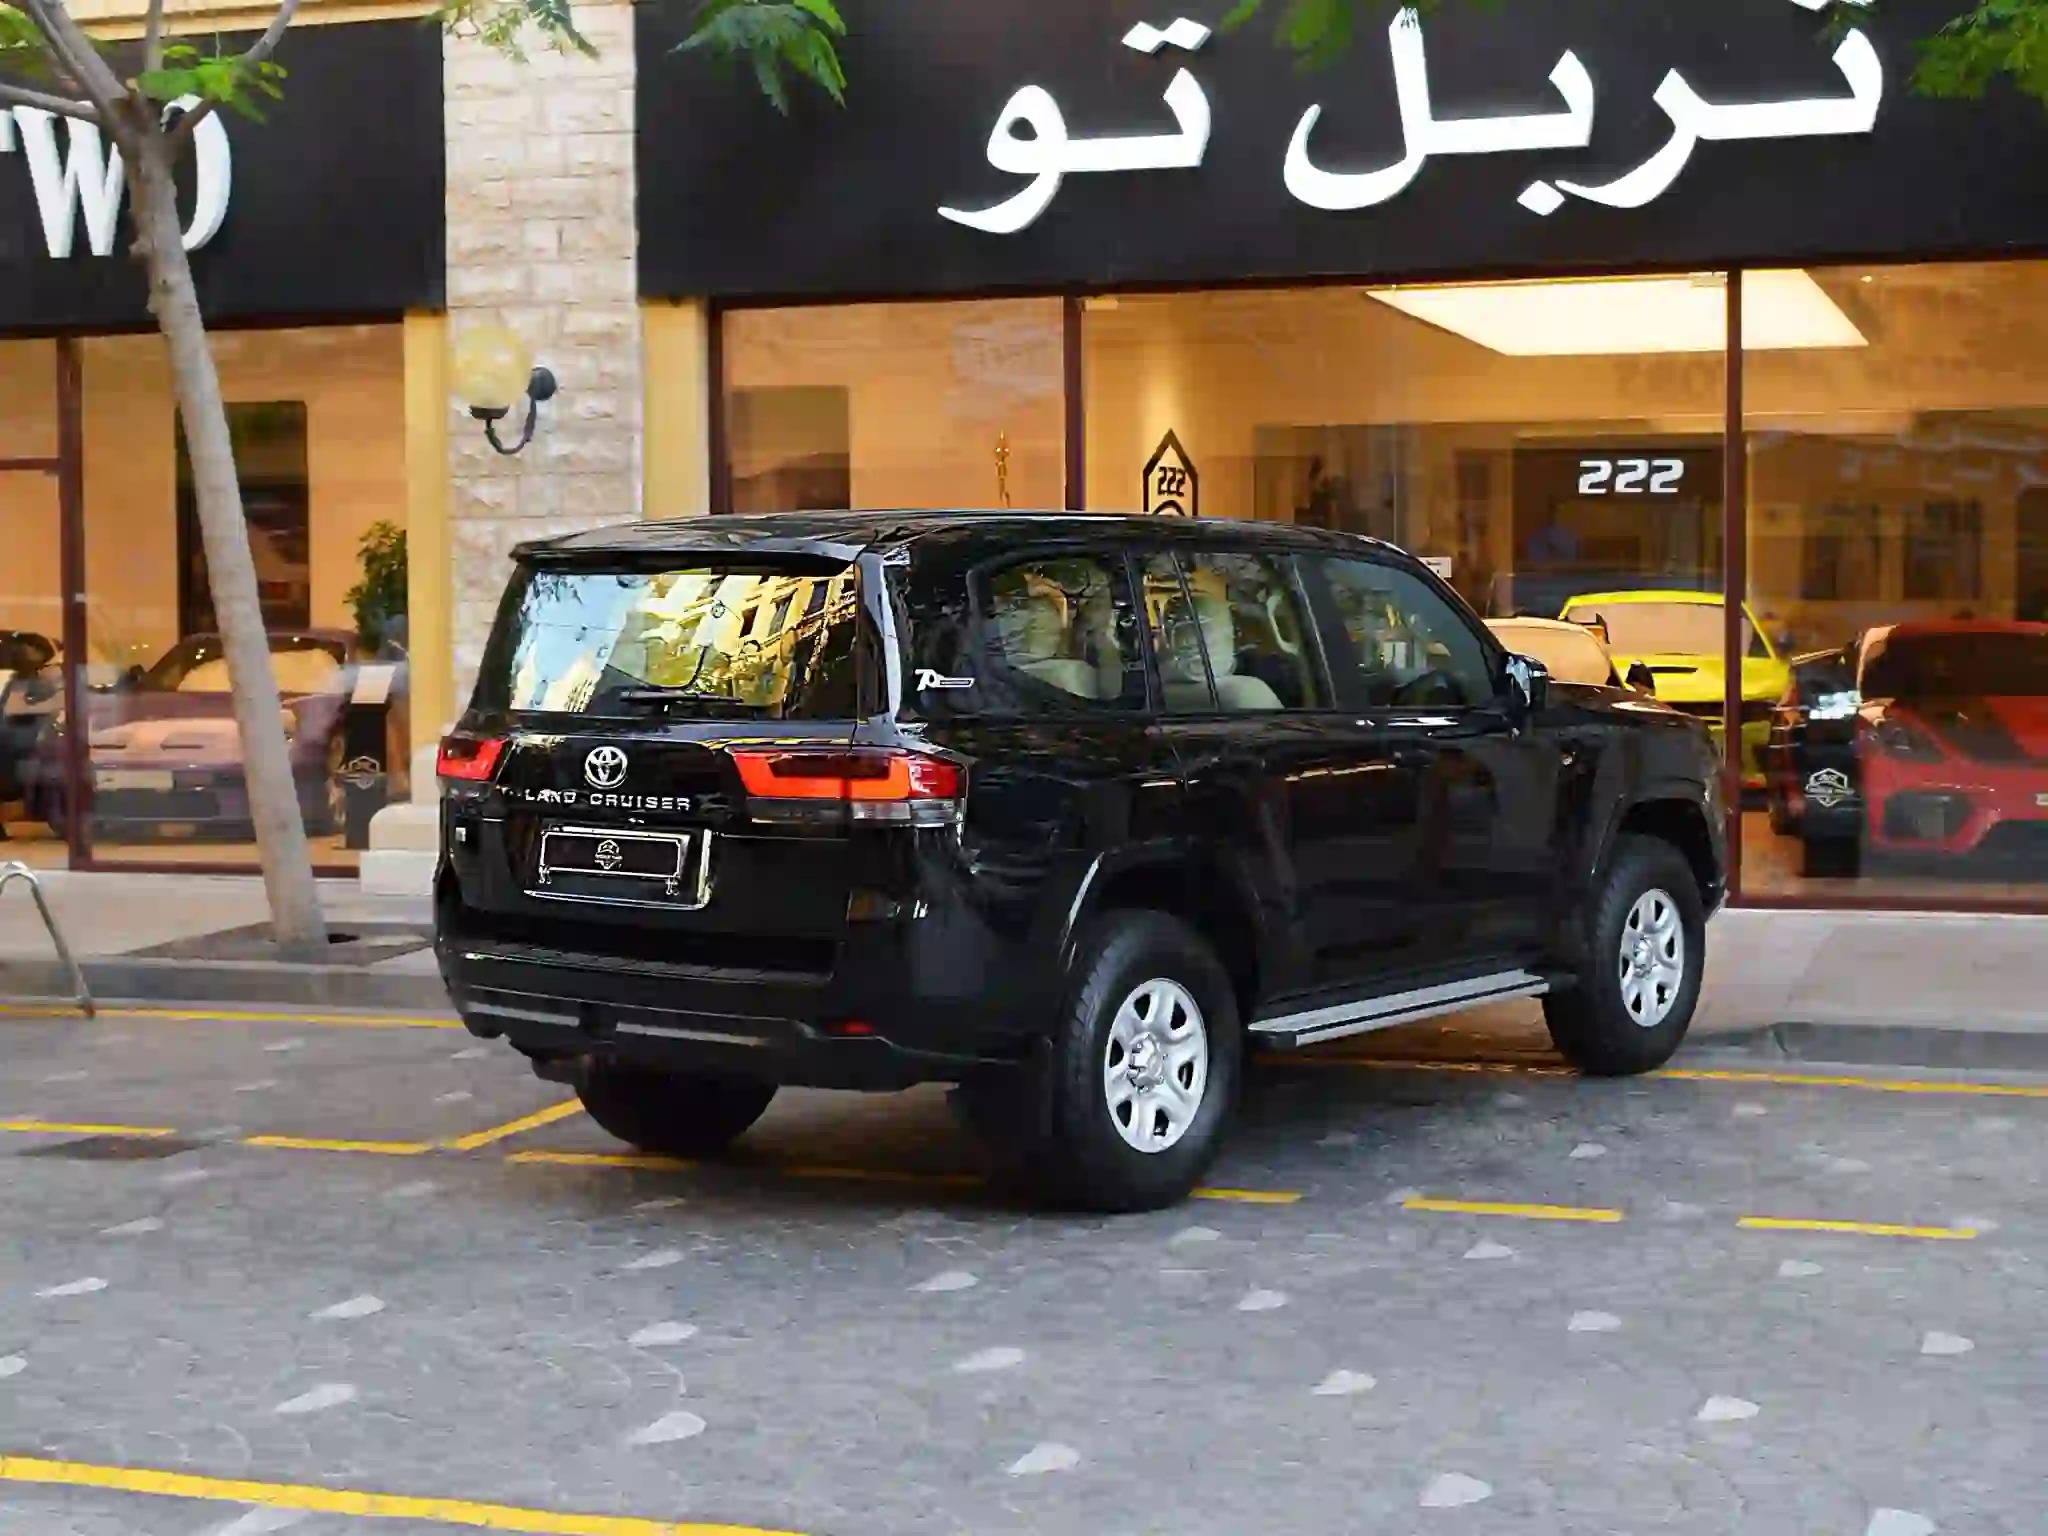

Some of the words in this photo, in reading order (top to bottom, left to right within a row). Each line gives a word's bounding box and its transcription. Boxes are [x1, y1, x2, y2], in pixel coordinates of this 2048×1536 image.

[938, 17, 1211, 234] تو
[0, 93, 231, 258] WO
[1157, 466, 1186, 497] 222
[1579, 459, 1684, 494] 222
[525, 788, 577, 804] LAND
[589, 793, 691, 811] CRUISER
